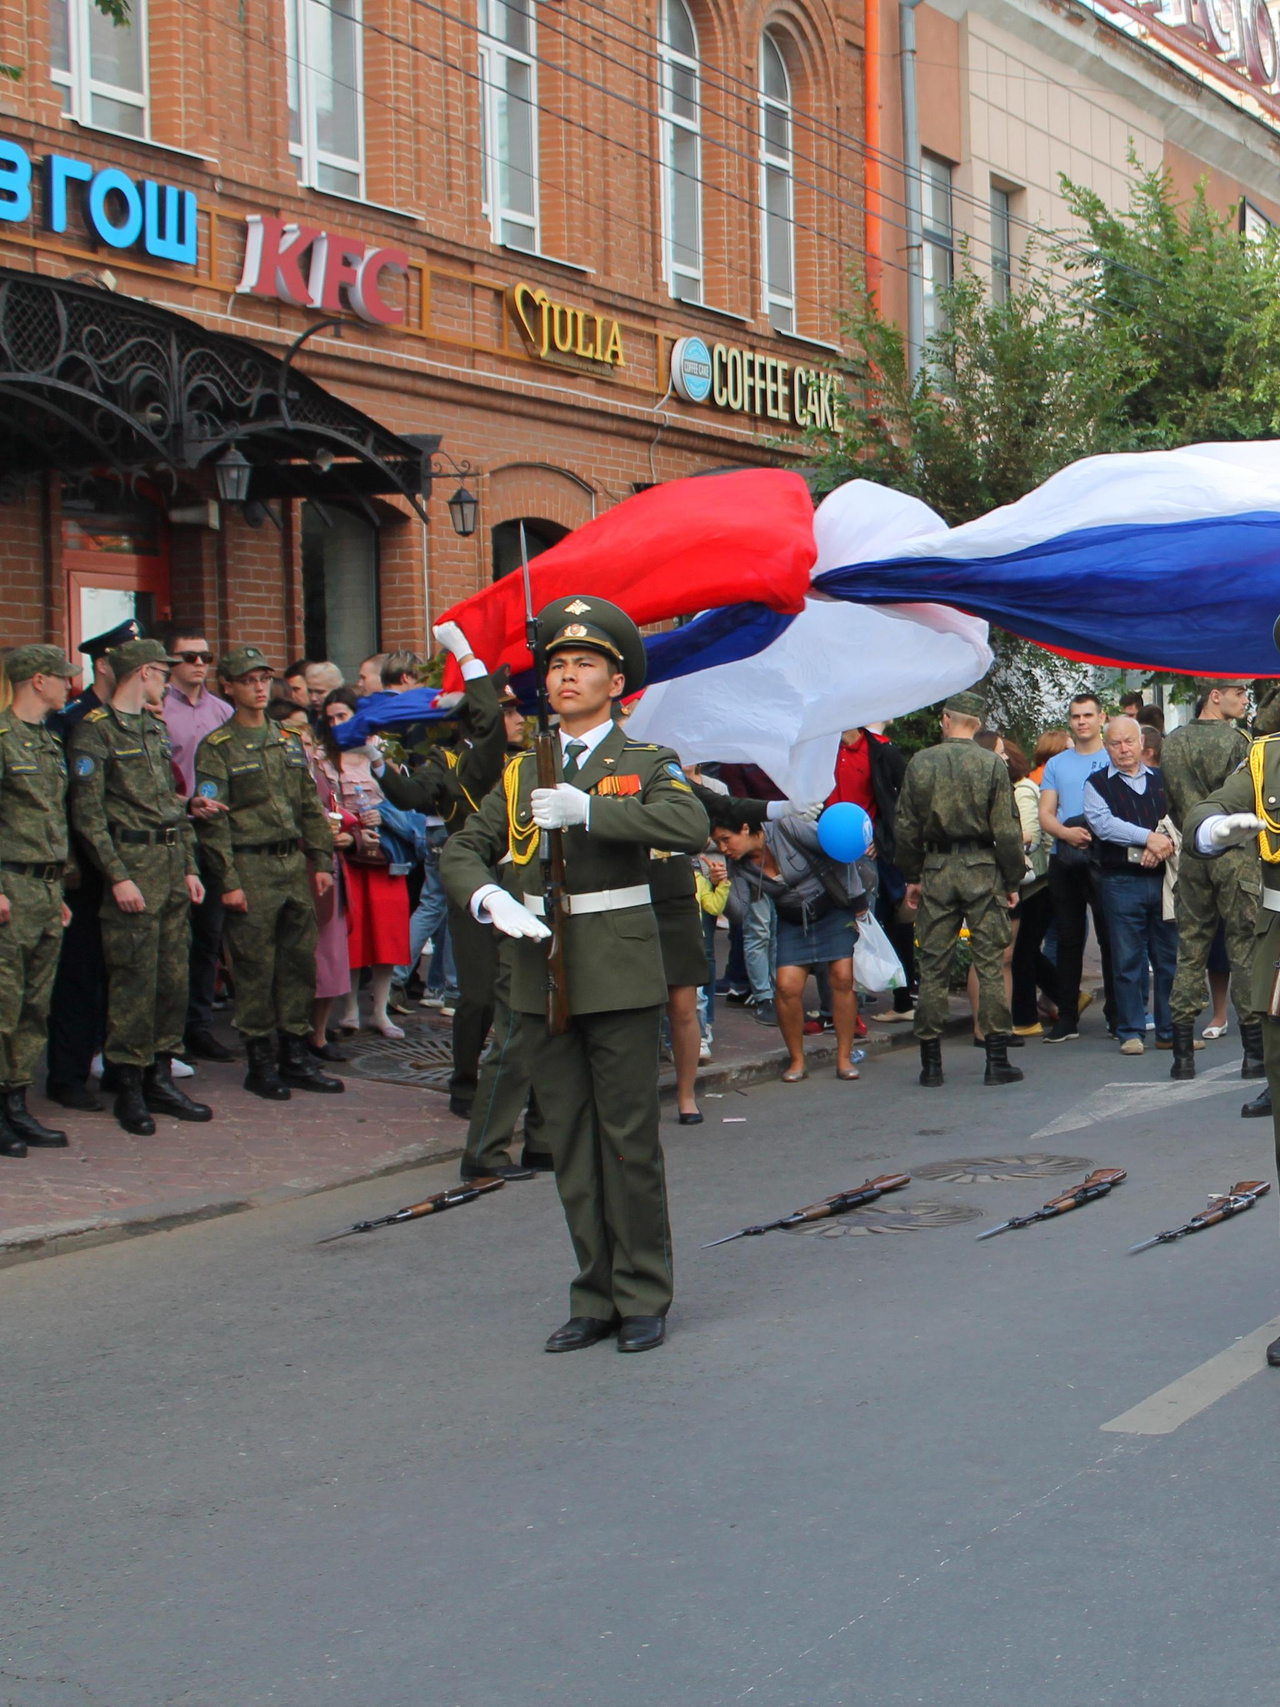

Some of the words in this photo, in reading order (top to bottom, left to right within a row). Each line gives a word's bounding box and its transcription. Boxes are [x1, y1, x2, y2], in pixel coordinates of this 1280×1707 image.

[49, 153, 198, 266] ГОШ
[235, 213, 409, 326] KFC
[538, 297, 626, 367] JULIA
[684, 360, 699, 375] COFFEE
[699, 363, 710, 378] CAKE
[712, 342, 790, 421] COFFEE
[794, 365, 845, 433] CAKE
